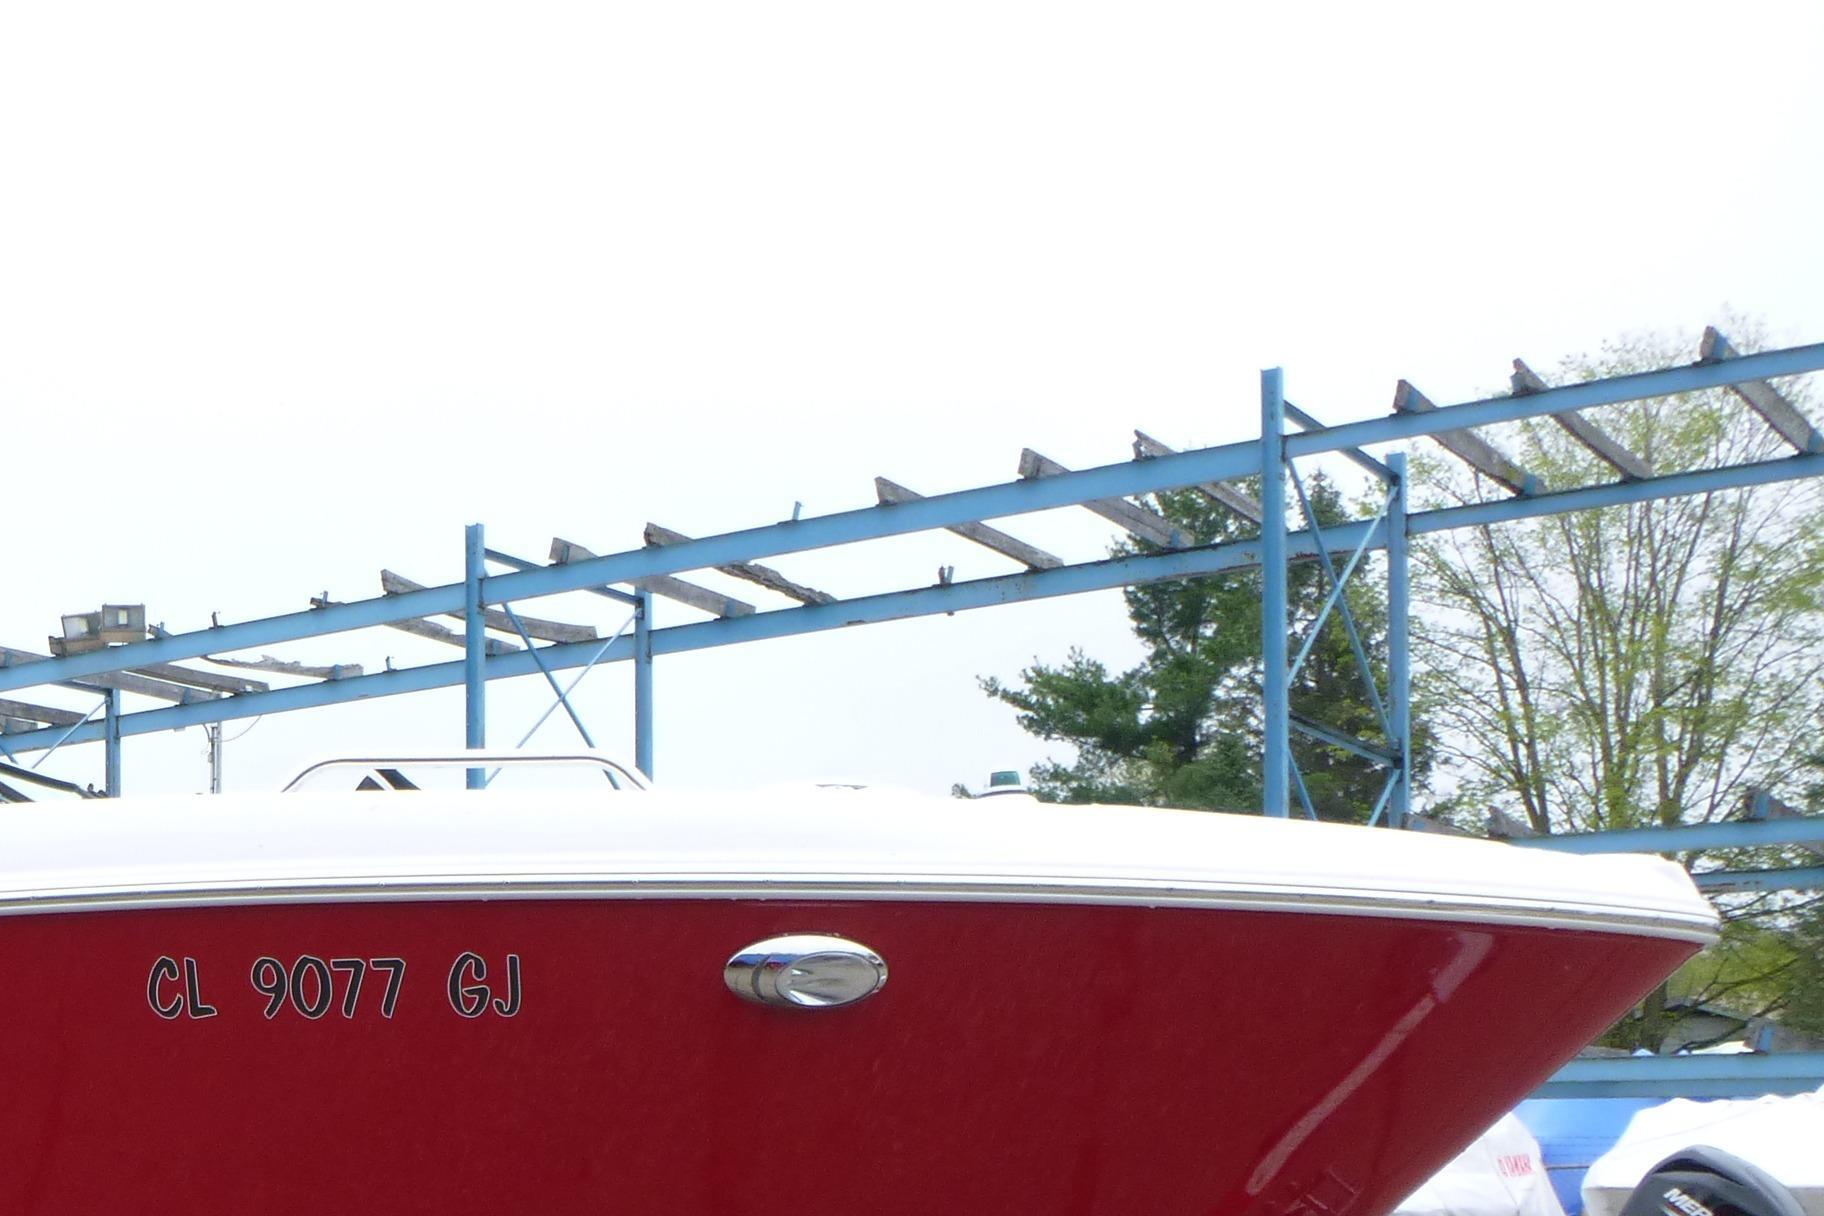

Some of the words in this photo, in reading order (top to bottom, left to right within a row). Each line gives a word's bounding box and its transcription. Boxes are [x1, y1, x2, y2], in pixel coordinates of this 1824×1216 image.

[146, 954, 218, 1020] CL
[250, 954, 407, 1020] 9077
[446, 951, 523, 1019] GJ
